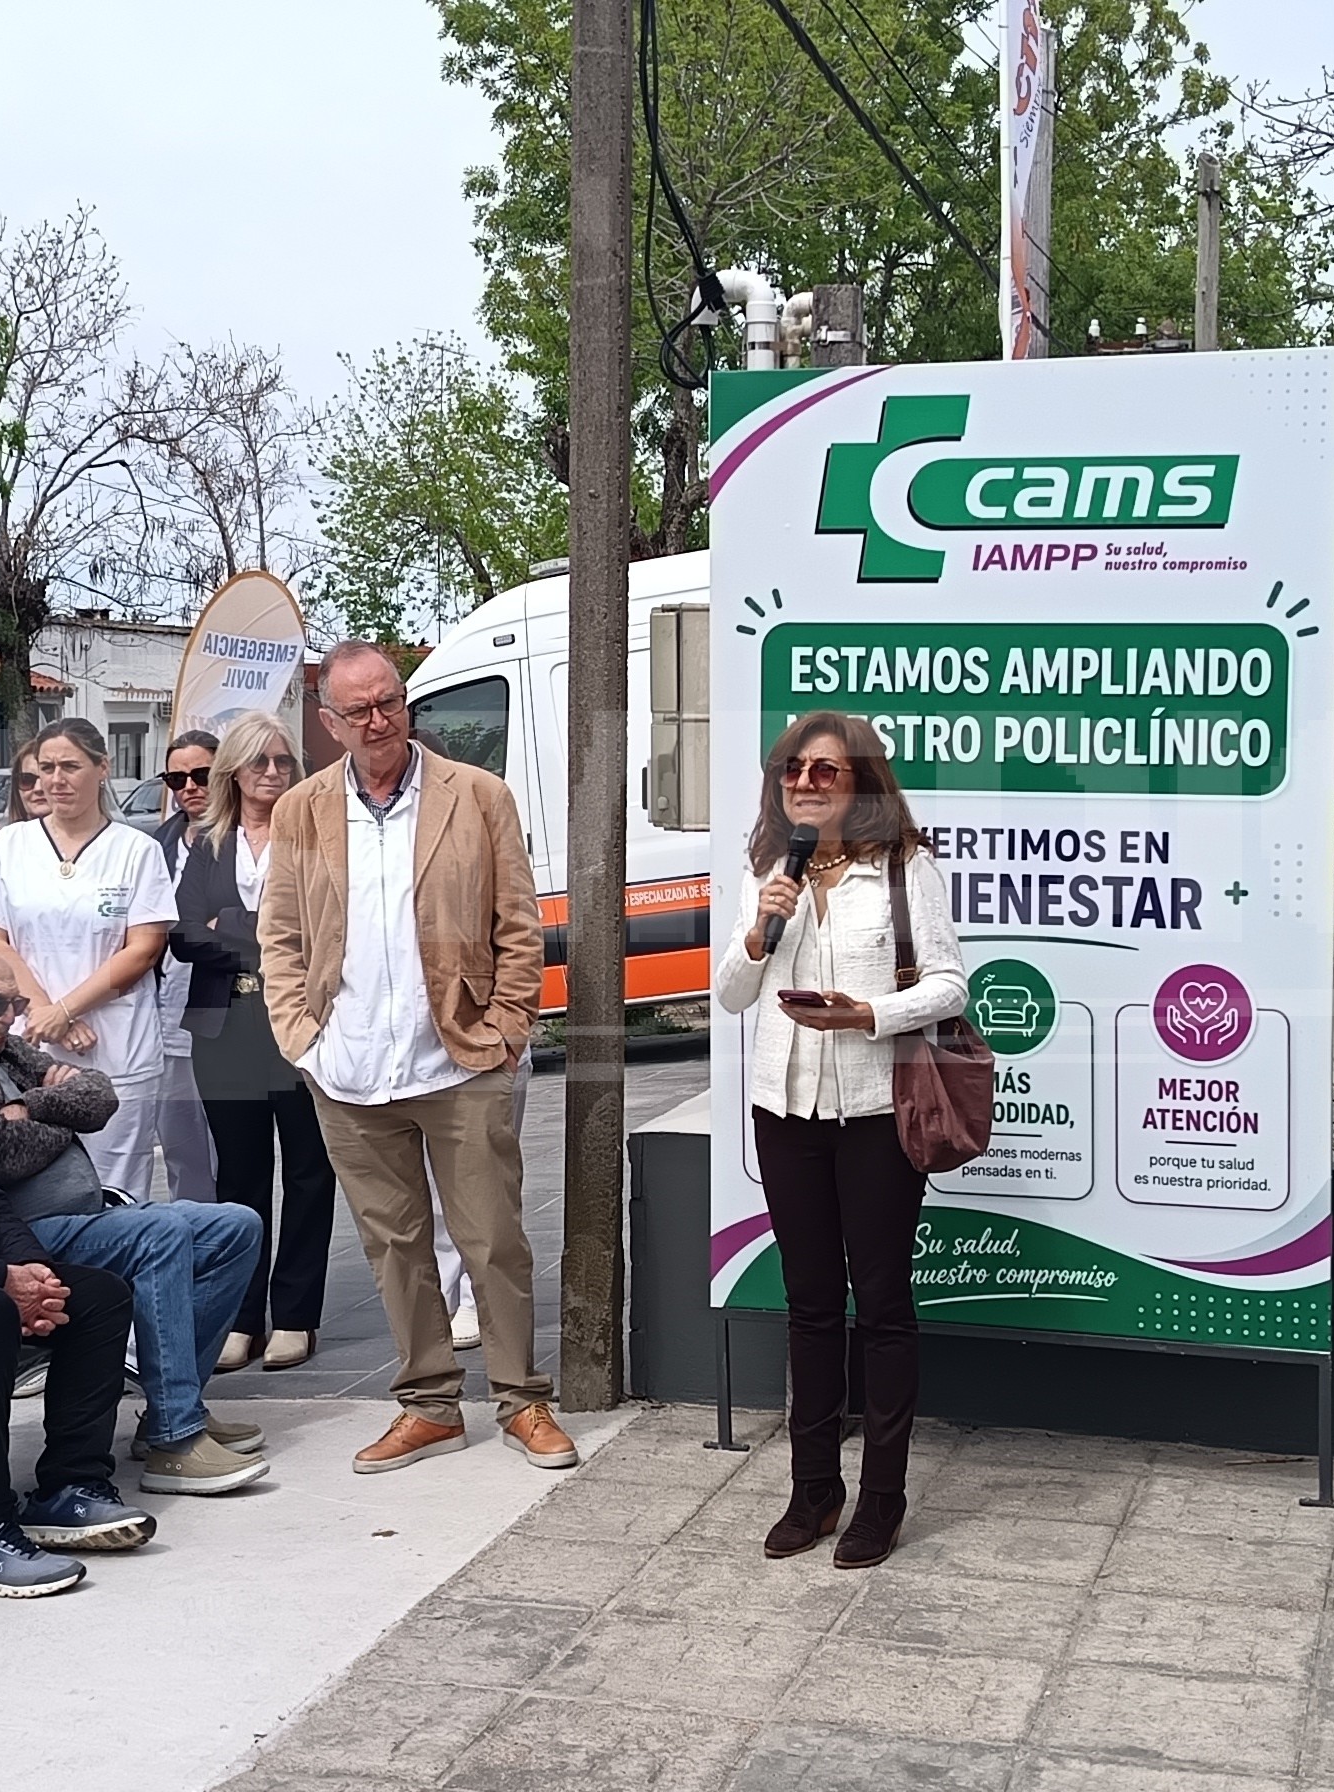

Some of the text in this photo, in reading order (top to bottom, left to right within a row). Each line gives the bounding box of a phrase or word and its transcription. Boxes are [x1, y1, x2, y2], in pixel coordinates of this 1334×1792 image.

[965, 465, 1216, 519] cams
[972, 543, 1098, 571] IAMPP
[1105, 541, 1168, 558] Su salud,
[1104, 556, 1248, 573] nuestro compromiso
[790, 646, 1272, 698] ESTAMOS AMPLIANDO
[994, 706, 1272, 768] POLICLÍNICO
[921, 826, 1170, 864] ERTIMOS EN
[629, 886, 688, 907] ESPECIALIZADA
[688, 884, 701, 899] DE
[951, 871, 1203, 930] IENESTAR
[1158, 1077, 1240, 1103] MEJOR
[993, 1101, 1075, 1129] ODIDAD,
[1142, 1105, 1259, 1134] ATENCIÓN
[1020, 1147, 1083, 1162] modernas
[1149, 1155, 1255, 1171] porque tu salud
[961, 1164, 1058, 1180] pensadas en ti.
[1134, 1174, 1272, 1192] es nuestra prioridad.
[911, 1222, 1022, 1260] Su salud,
[910, 1260, 1120, 1294] nuestro compromiso
